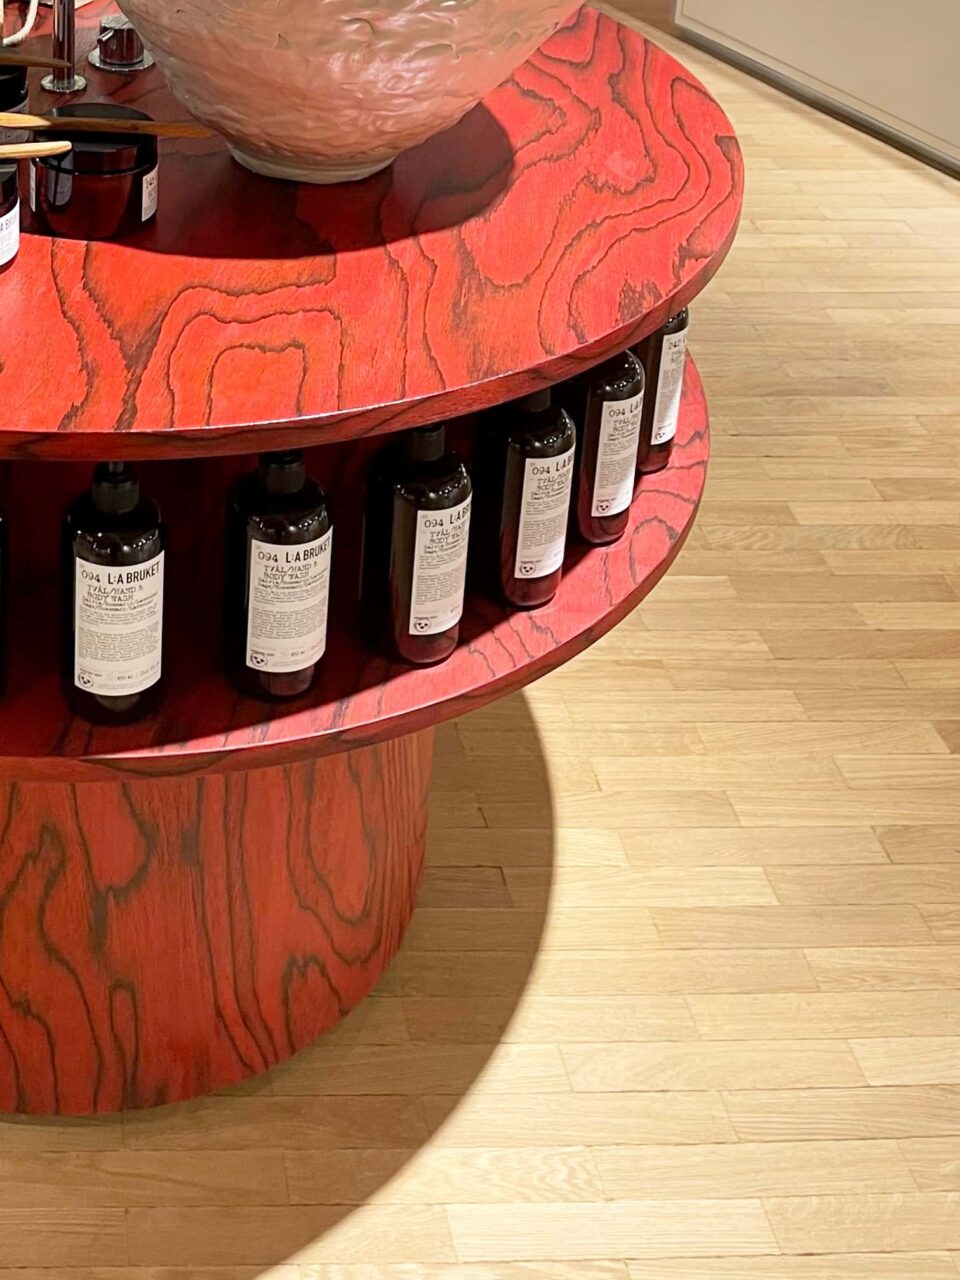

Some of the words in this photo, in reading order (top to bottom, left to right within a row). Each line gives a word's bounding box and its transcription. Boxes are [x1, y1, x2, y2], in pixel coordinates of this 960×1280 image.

[531, 465, 551, 476] 094
[423, 518, 445, 529] 094
[257, 551, 279, 563] 094
[285, 551, 302, 564] L:A
[81, 569, 101, 584] 094
[107, 572, 125, 586] L:A
[126, 560, 161, 585] BRUKET
